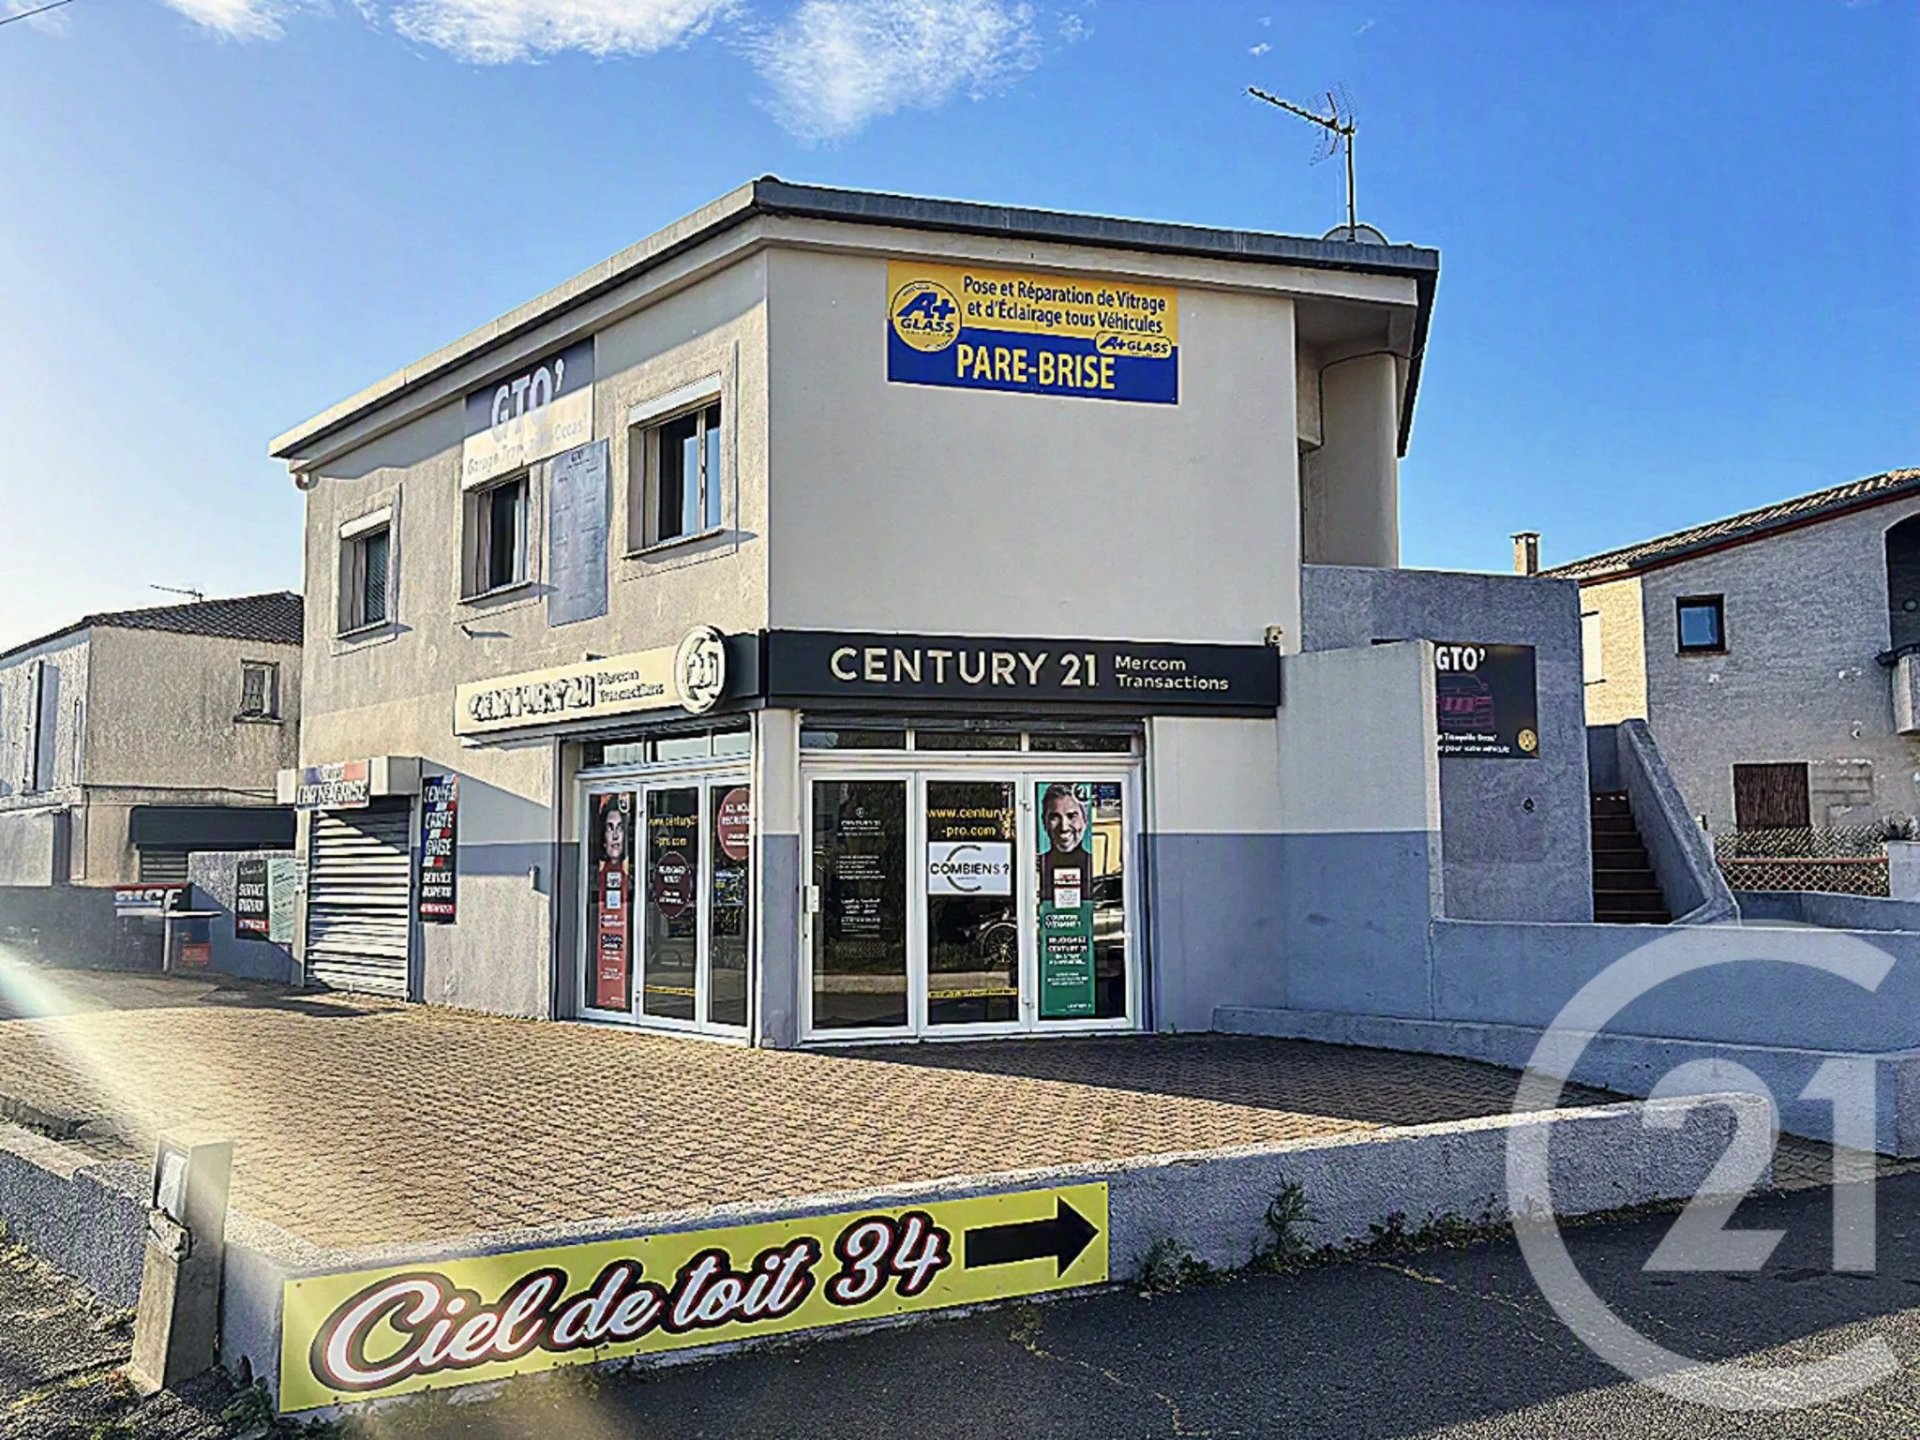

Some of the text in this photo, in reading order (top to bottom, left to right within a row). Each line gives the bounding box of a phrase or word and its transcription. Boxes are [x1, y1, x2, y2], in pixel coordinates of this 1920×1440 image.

[964, 275, 1165, 315] Pose et Réparation de Vitrage
[901, 318, 954, 333] GLASS
[967, 299, 1163, 333] et d'Éclairage tous Véhicules
[956, 344, 1116, 390] PARE-BRISE
[830, 646, 1098, 686] CENTURY 21
[1115, 655, 1186, 671] Mercom
[1115, 674, 1229, 690] Transactions
[930, 862, 1000, 875] COMBIENS
[314, 1212, 948, 1388] Ciel de toit 34
